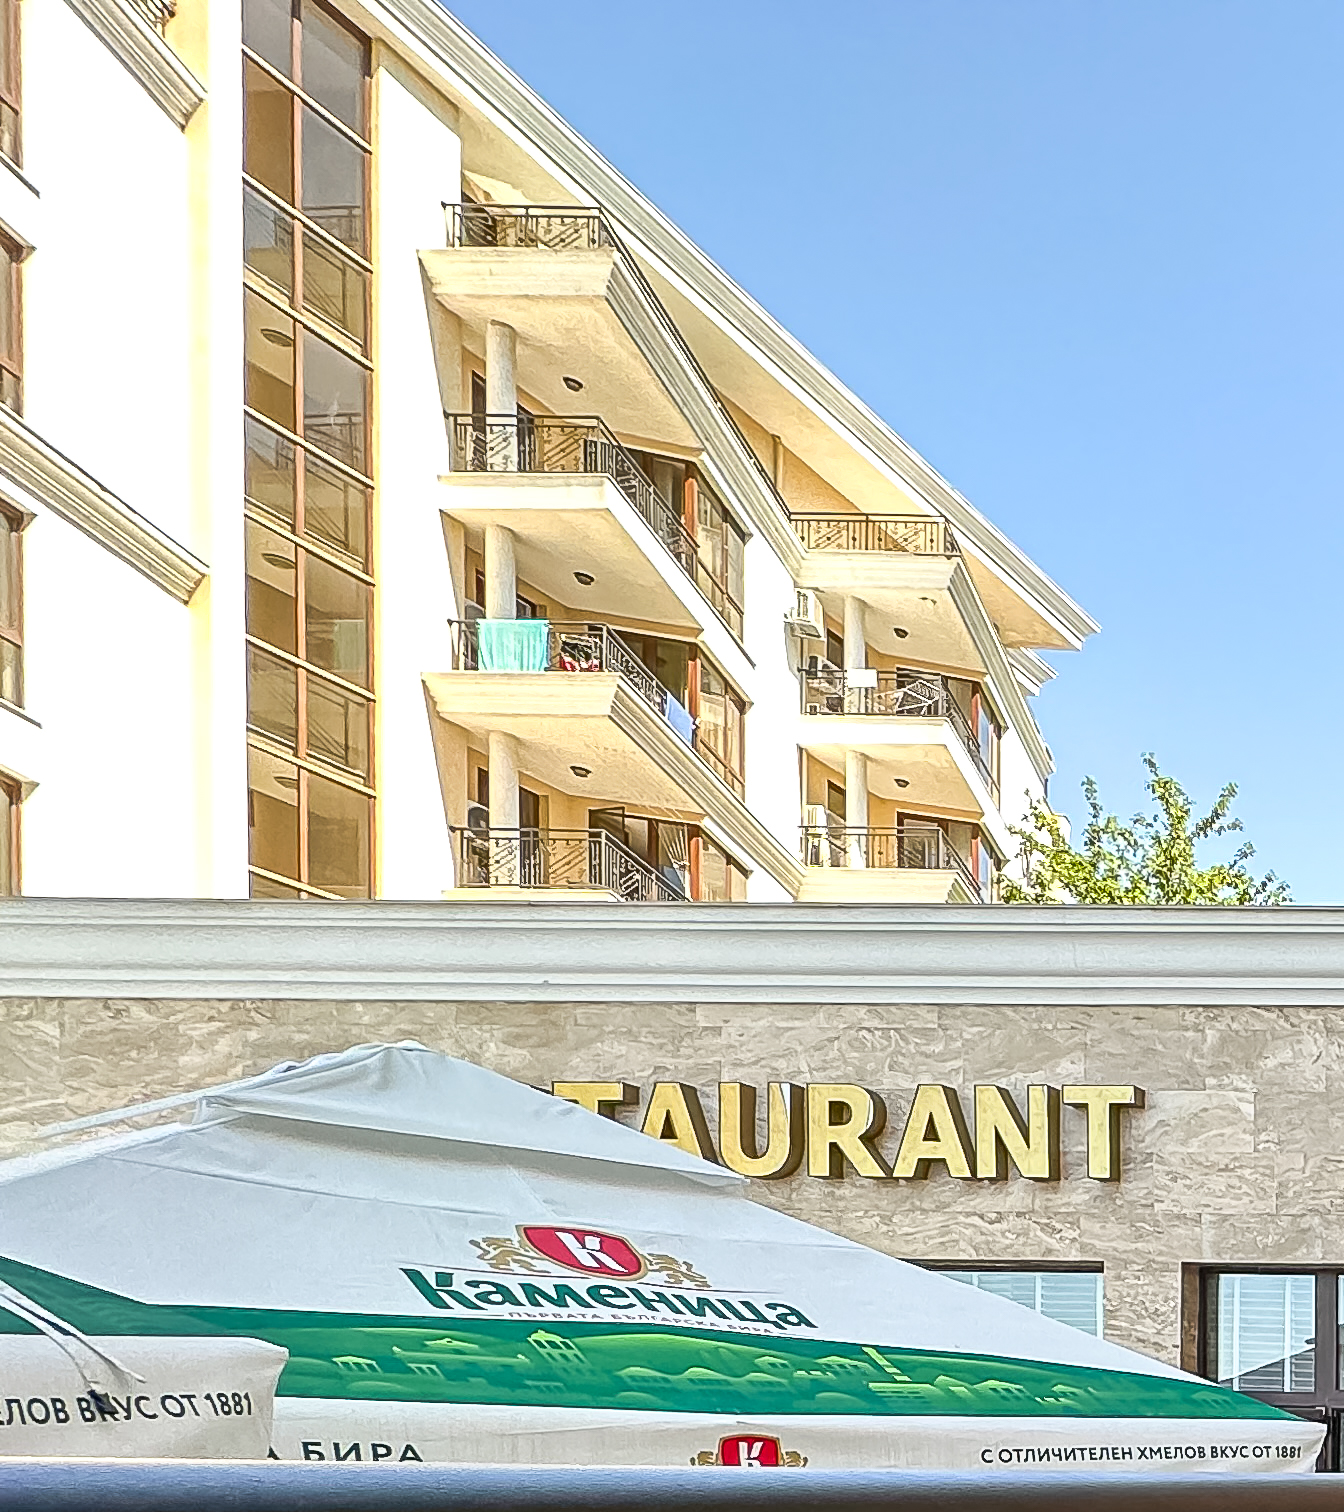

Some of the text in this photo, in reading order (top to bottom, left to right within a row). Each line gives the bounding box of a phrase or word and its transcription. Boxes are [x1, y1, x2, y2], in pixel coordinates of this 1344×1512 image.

[399, 1267, 819, 1330] Каменица
[508, 1311, 604, 1320] ПЪРВАТА
[0, 1397, 70, 1425] ЛОВ
[160, 1394, 200, 1418] ОТ
[203, 1391, 252, 1416] 1881
[301, 1441, 424, 1462] БИРА
[981, 1445, 1302, 1463] С ОТЛИЧИТЕЛЕН ХМЕЛОВ ВКУС ОТ 1881
